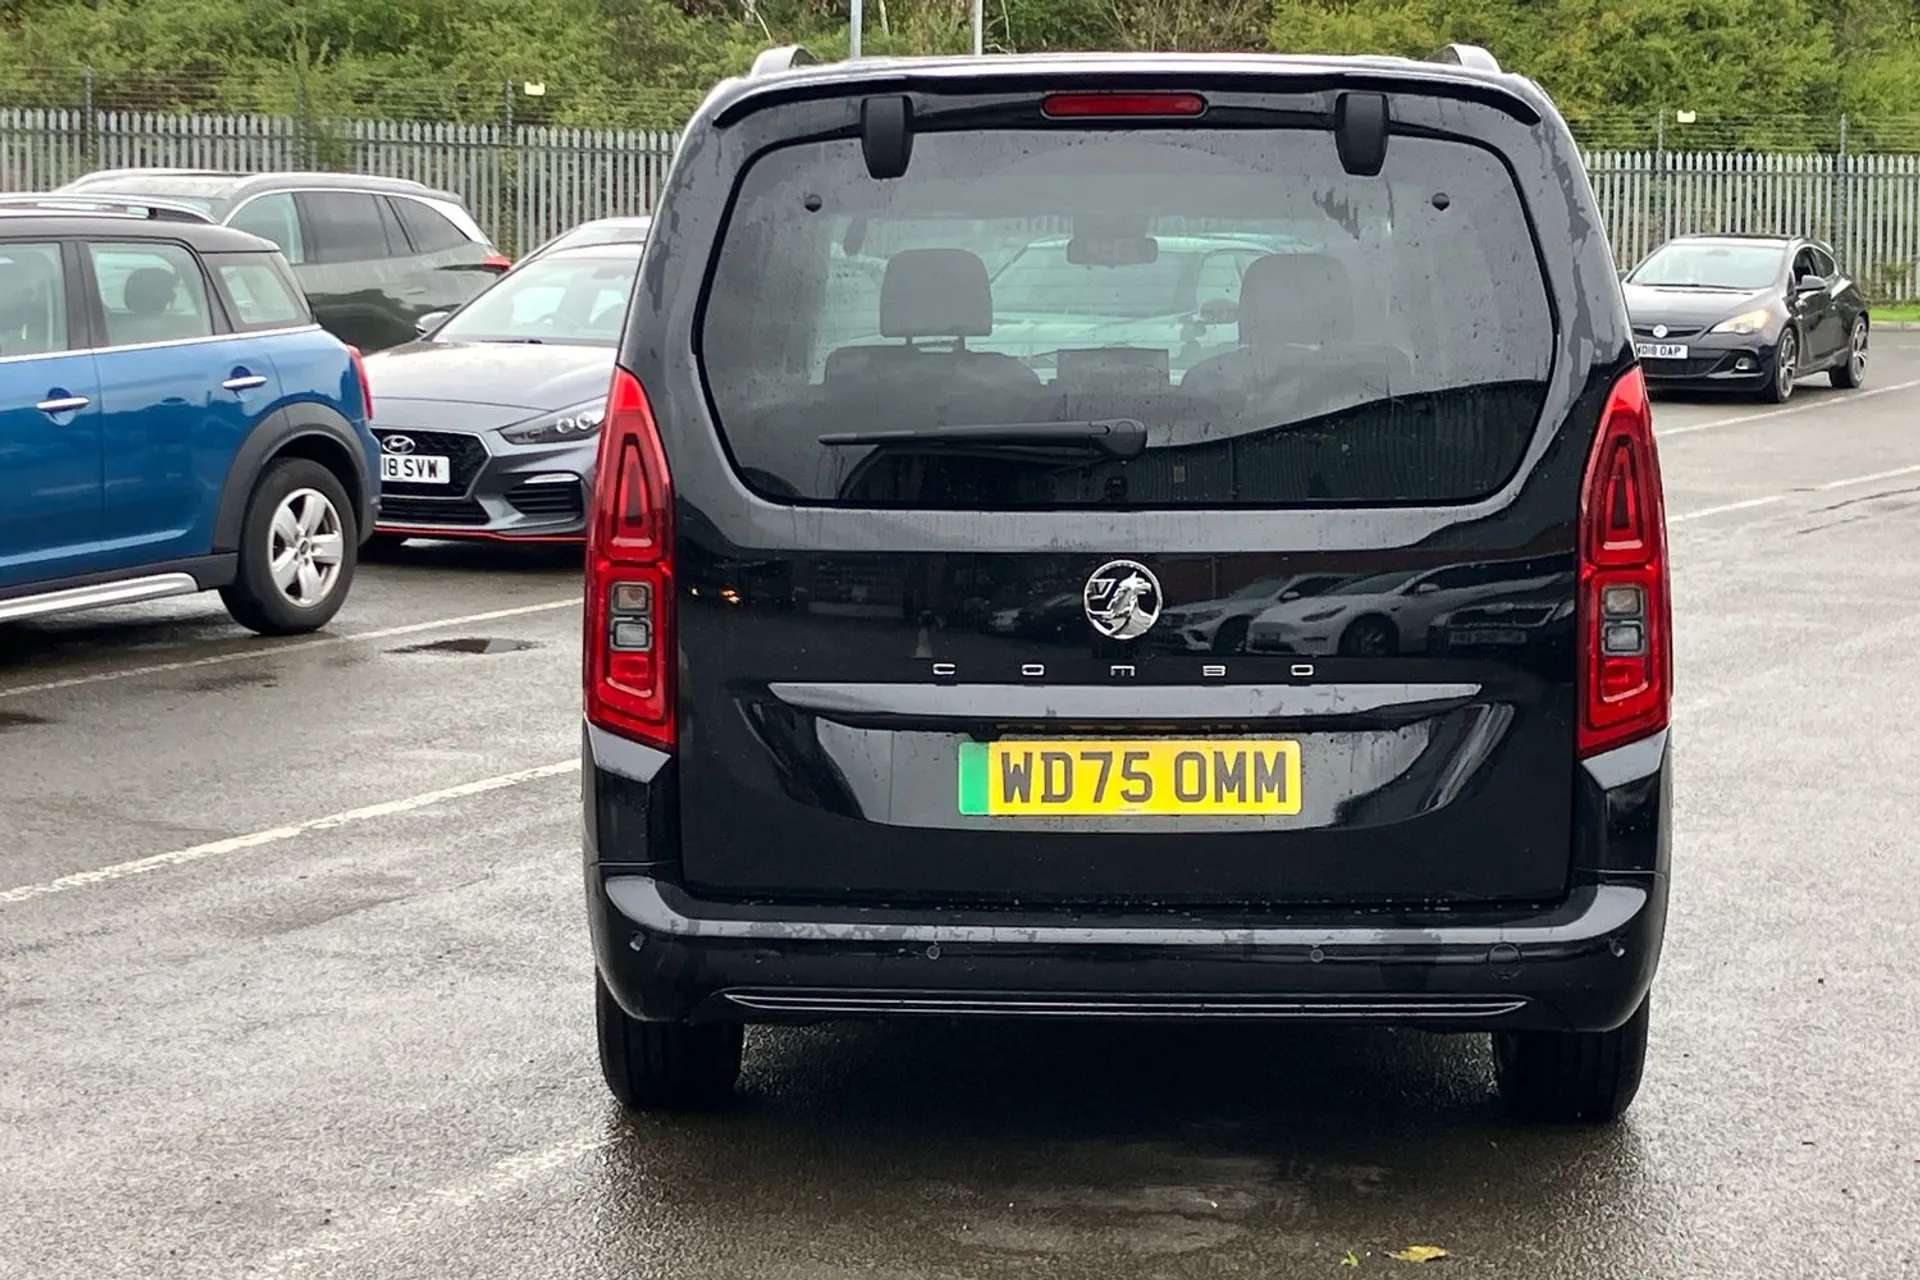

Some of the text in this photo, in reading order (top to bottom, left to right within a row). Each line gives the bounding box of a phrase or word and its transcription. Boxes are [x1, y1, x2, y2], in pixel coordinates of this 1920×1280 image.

[404, 458, 437, 478] SVW
[932, 662, 1314, 676] COMBO
[1001, 751, 1287, 803] WD75 OMM
